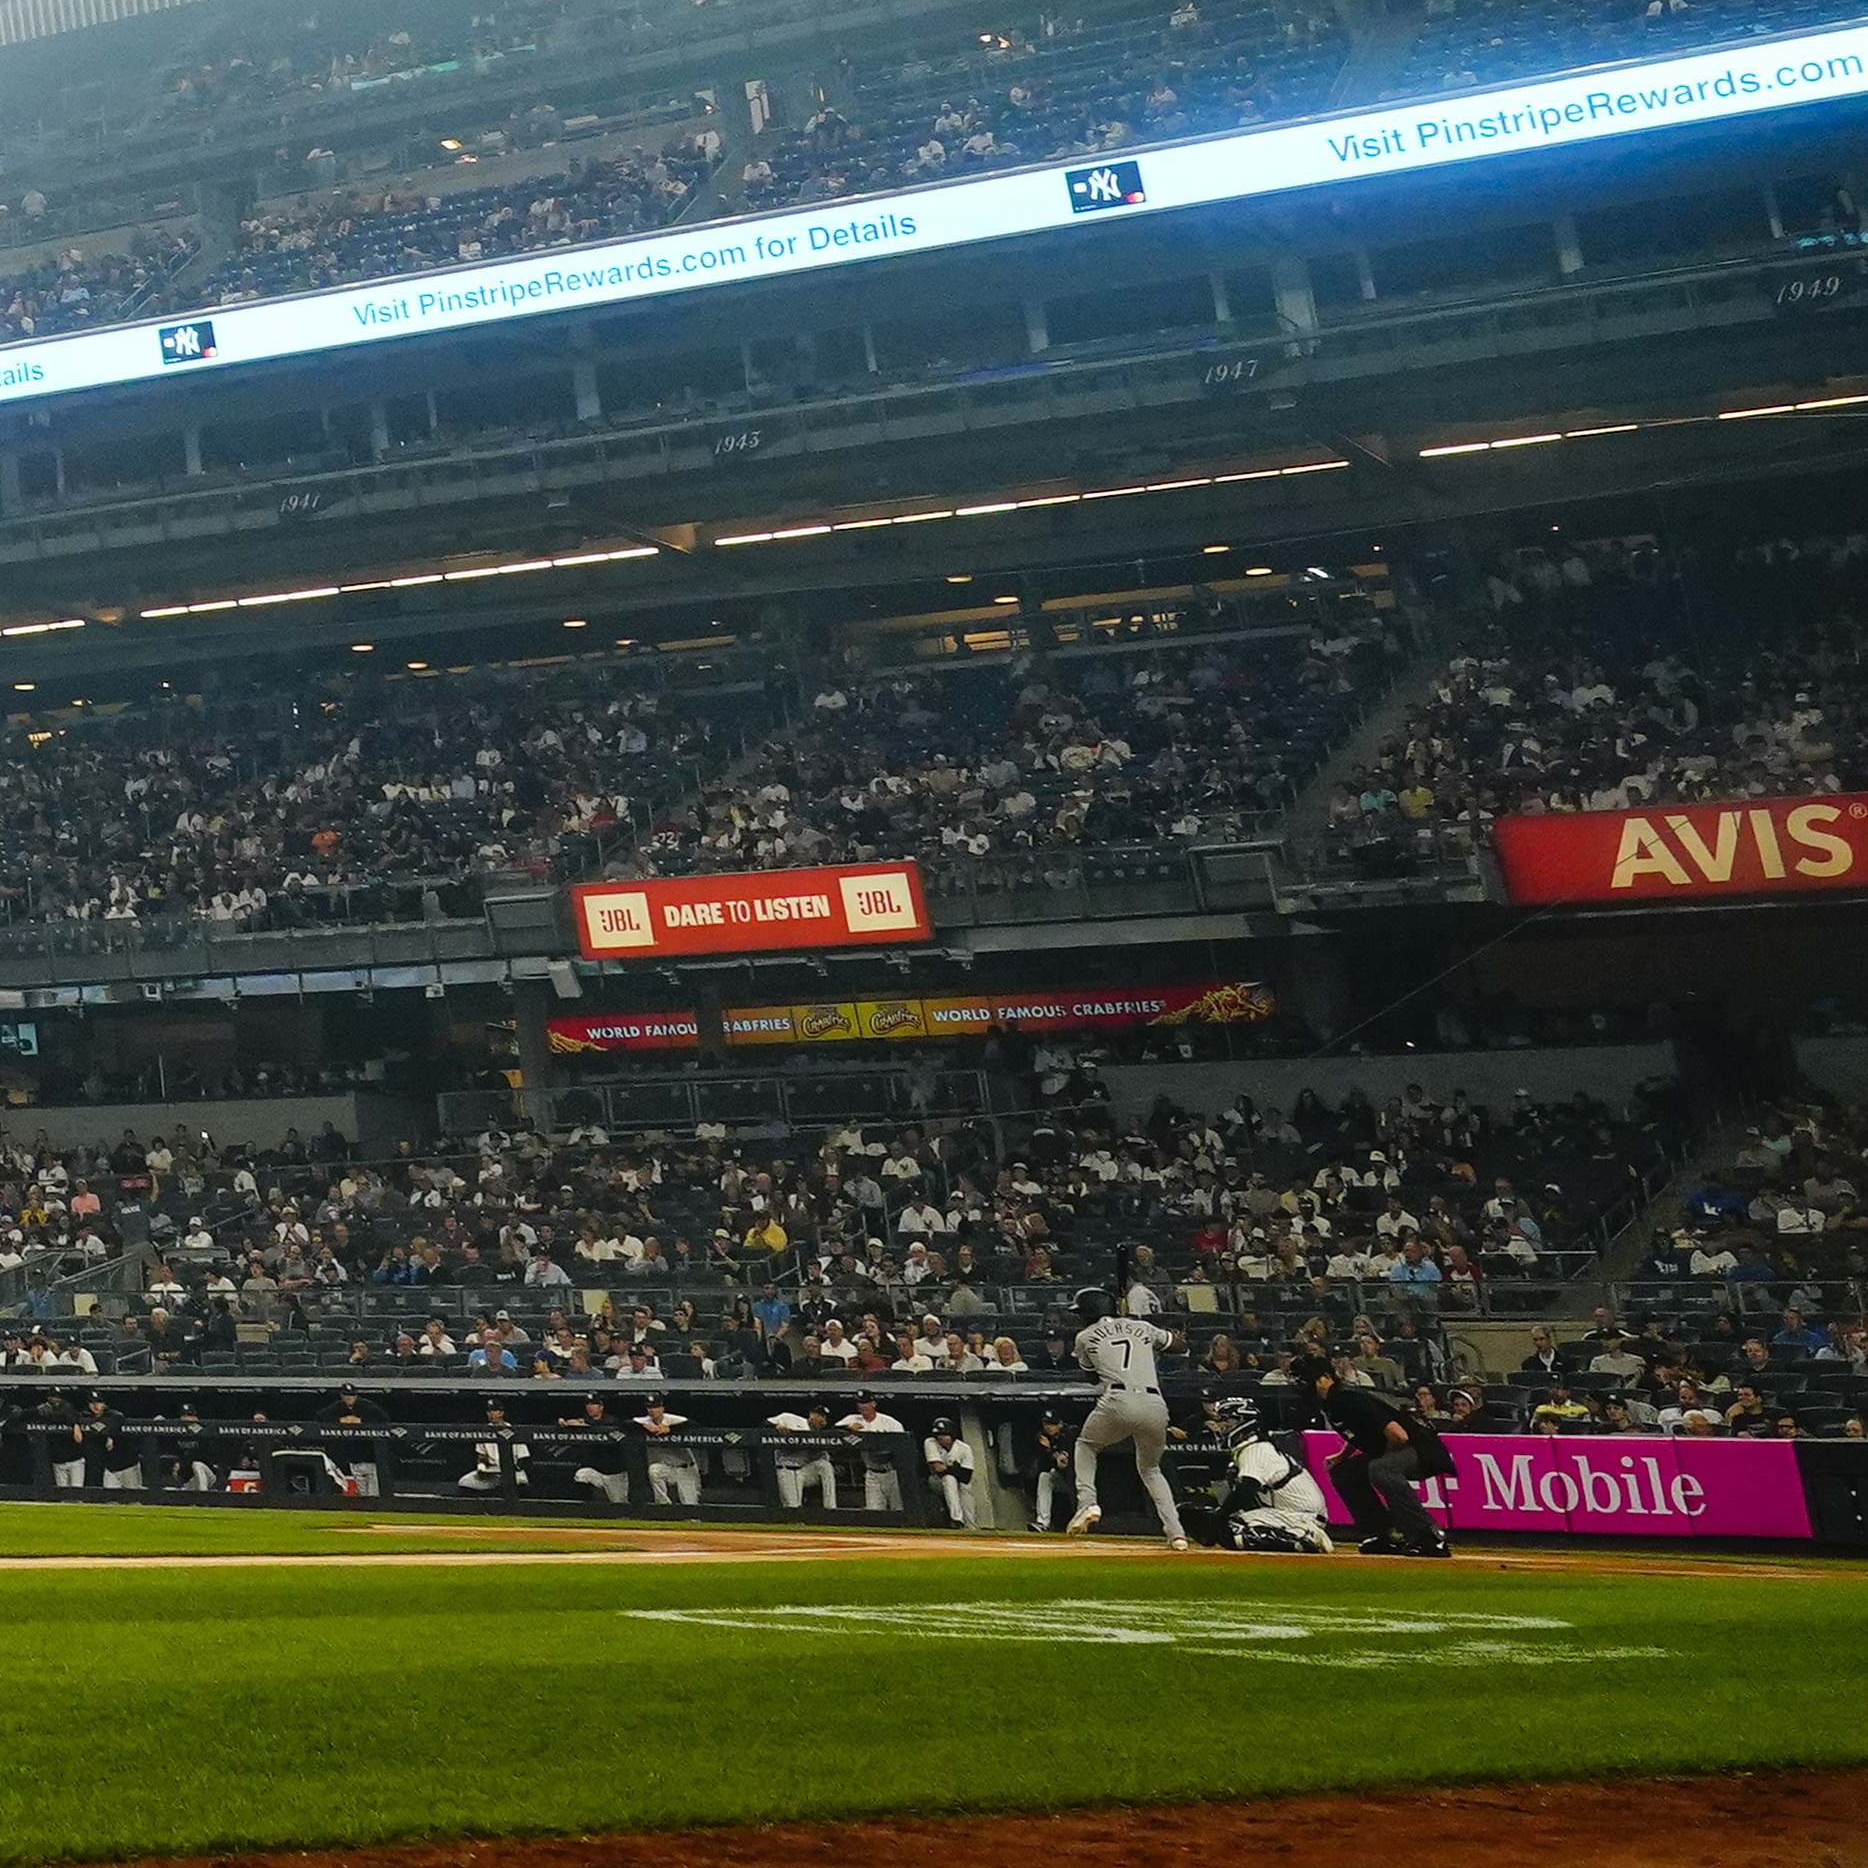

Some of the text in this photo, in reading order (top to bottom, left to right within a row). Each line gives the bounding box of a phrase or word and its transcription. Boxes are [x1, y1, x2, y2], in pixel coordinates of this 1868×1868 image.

[1327, 54, 1864, 163] Visit PinstripeRewards.com
[353, 211, 917, 327] Visit PinstripeRewards.com for Details
[1777, 277, 1840, 303] 1949
[1206, 359, 1258, 383] 1947
[1610, 803, 1854, 889] AVIS
[600, 890, 902, 933] JBL DARE TO LISTEN JBL
[932, 1000, 1161, 1023] WORLD FAMOUS CRABFRIES
[587, 1021, 698, 1039] WORLD FAMOU
[1087, 1323, 1152, 1355] ANDERSON
[1111, 1336, 1131, 1370] 7
[320, 1429, 391, 1438] BANK OF AMERICA
[425, 1431, 498, 1440] BANK OF AMERICA
[533, 1433, 609, 1442] BANK OF AMERICA
[671, 1435, 682, 1443] OF
[684, 1435, 724, 1444] AMERICA
[762, 1437, 843, 1446] BANK OF AMERICA
[1164, 1443, 1186, 1452] ANK
[1187, 1443, 1198, 1451] OF
[1472, 1453, 1707, 1517] Mobile
